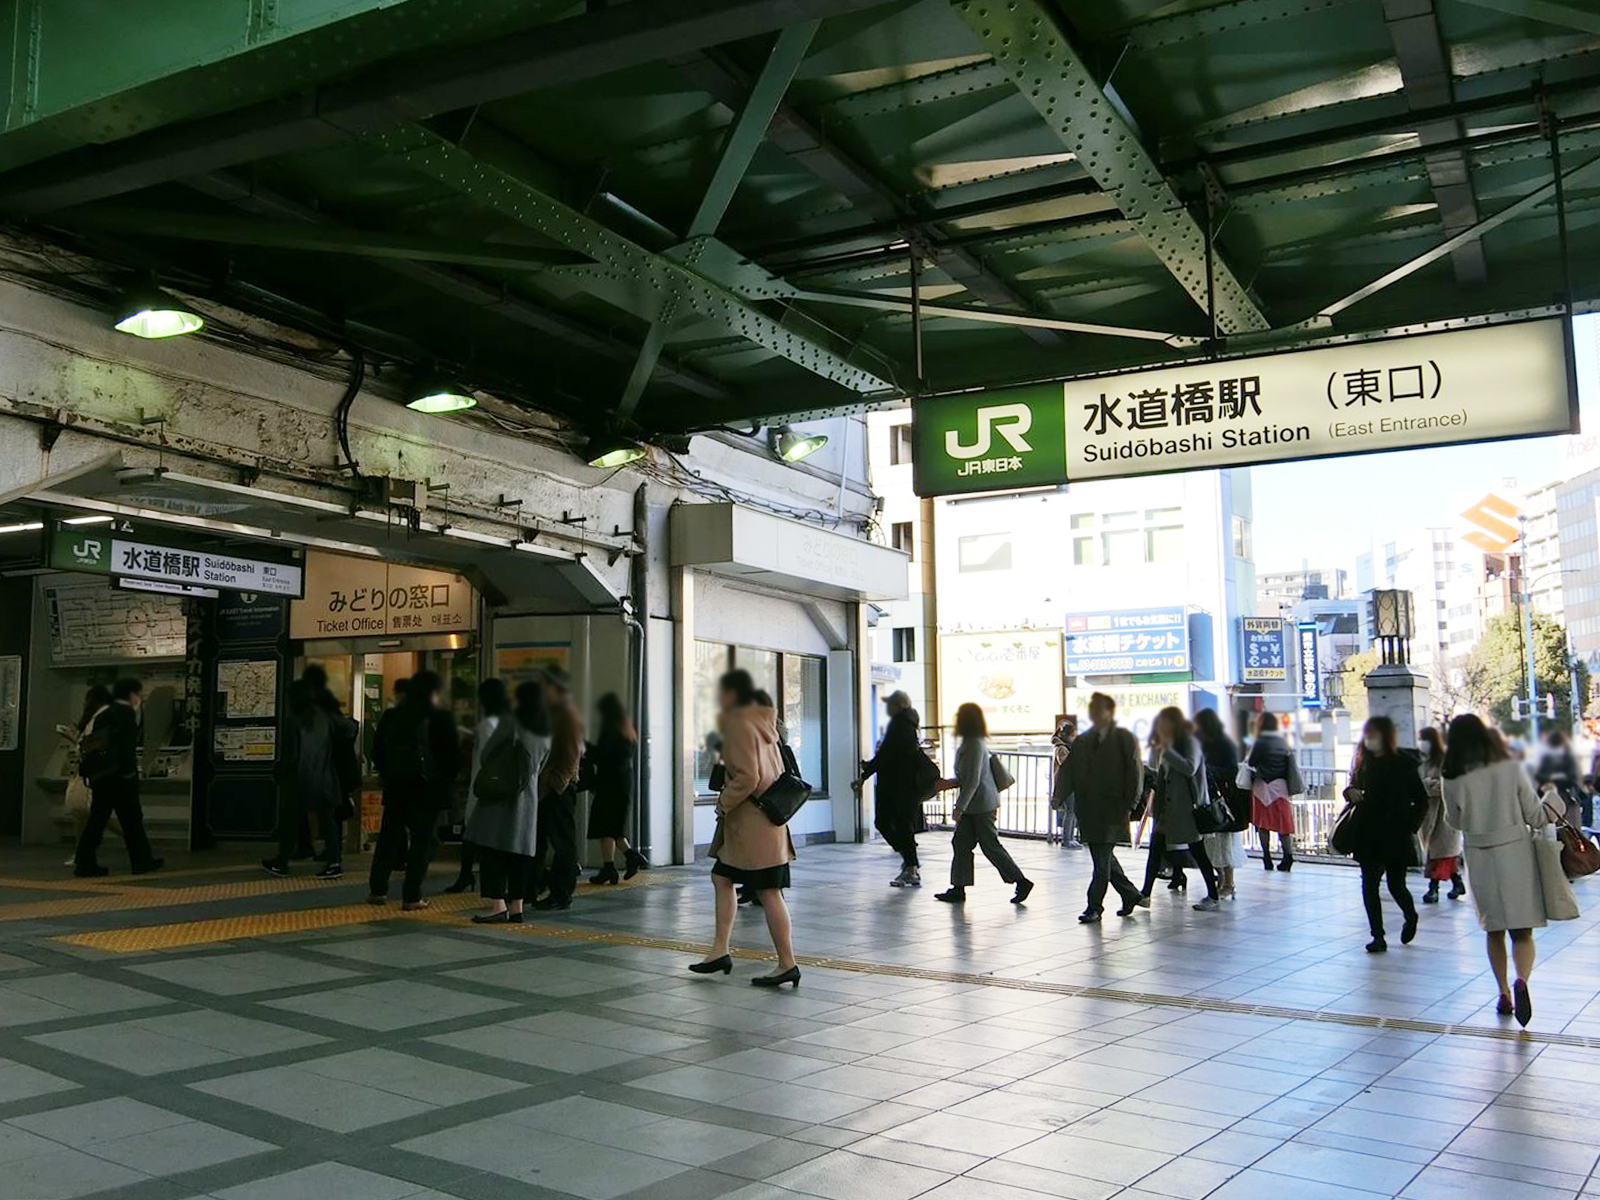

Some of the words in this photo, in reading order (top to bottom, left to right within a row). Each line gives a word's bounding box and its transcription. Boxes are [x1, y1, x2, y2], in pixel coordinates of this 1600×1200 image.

[1083, 376, 1262, 436] 水道橋駅
[1325, 360, 1445, 412] （東口）
[945, 404, 1034, 454] JR
[1083, 430, 1213, 464] Suidōbashi
[1221, 421, 1311, 449] Station
[1327, 417, 1375, 441] (East
[1380, 408, 1468, 436] Entrance)
[957, 455, 1023, 477] JR東日本
[73, 540, 102, 560] JR
[124, 549, 200, 578] 水道橋駅
[204, 558, 255, 574] Suidōbashi
[263, 566, 277, 577] 東口
[204, 570, 237, 584] Station
[329, 585, 449, 613] みどりの窓口
[317, 619, 349, 633] Ticket
[352, 617, 384, 631] Office
[432, 613, 462, 626] 매표소
[1073, 633, 1179, 653] 水道橋チケット
[1129, 692, 1179, 707] EXCHANGE
